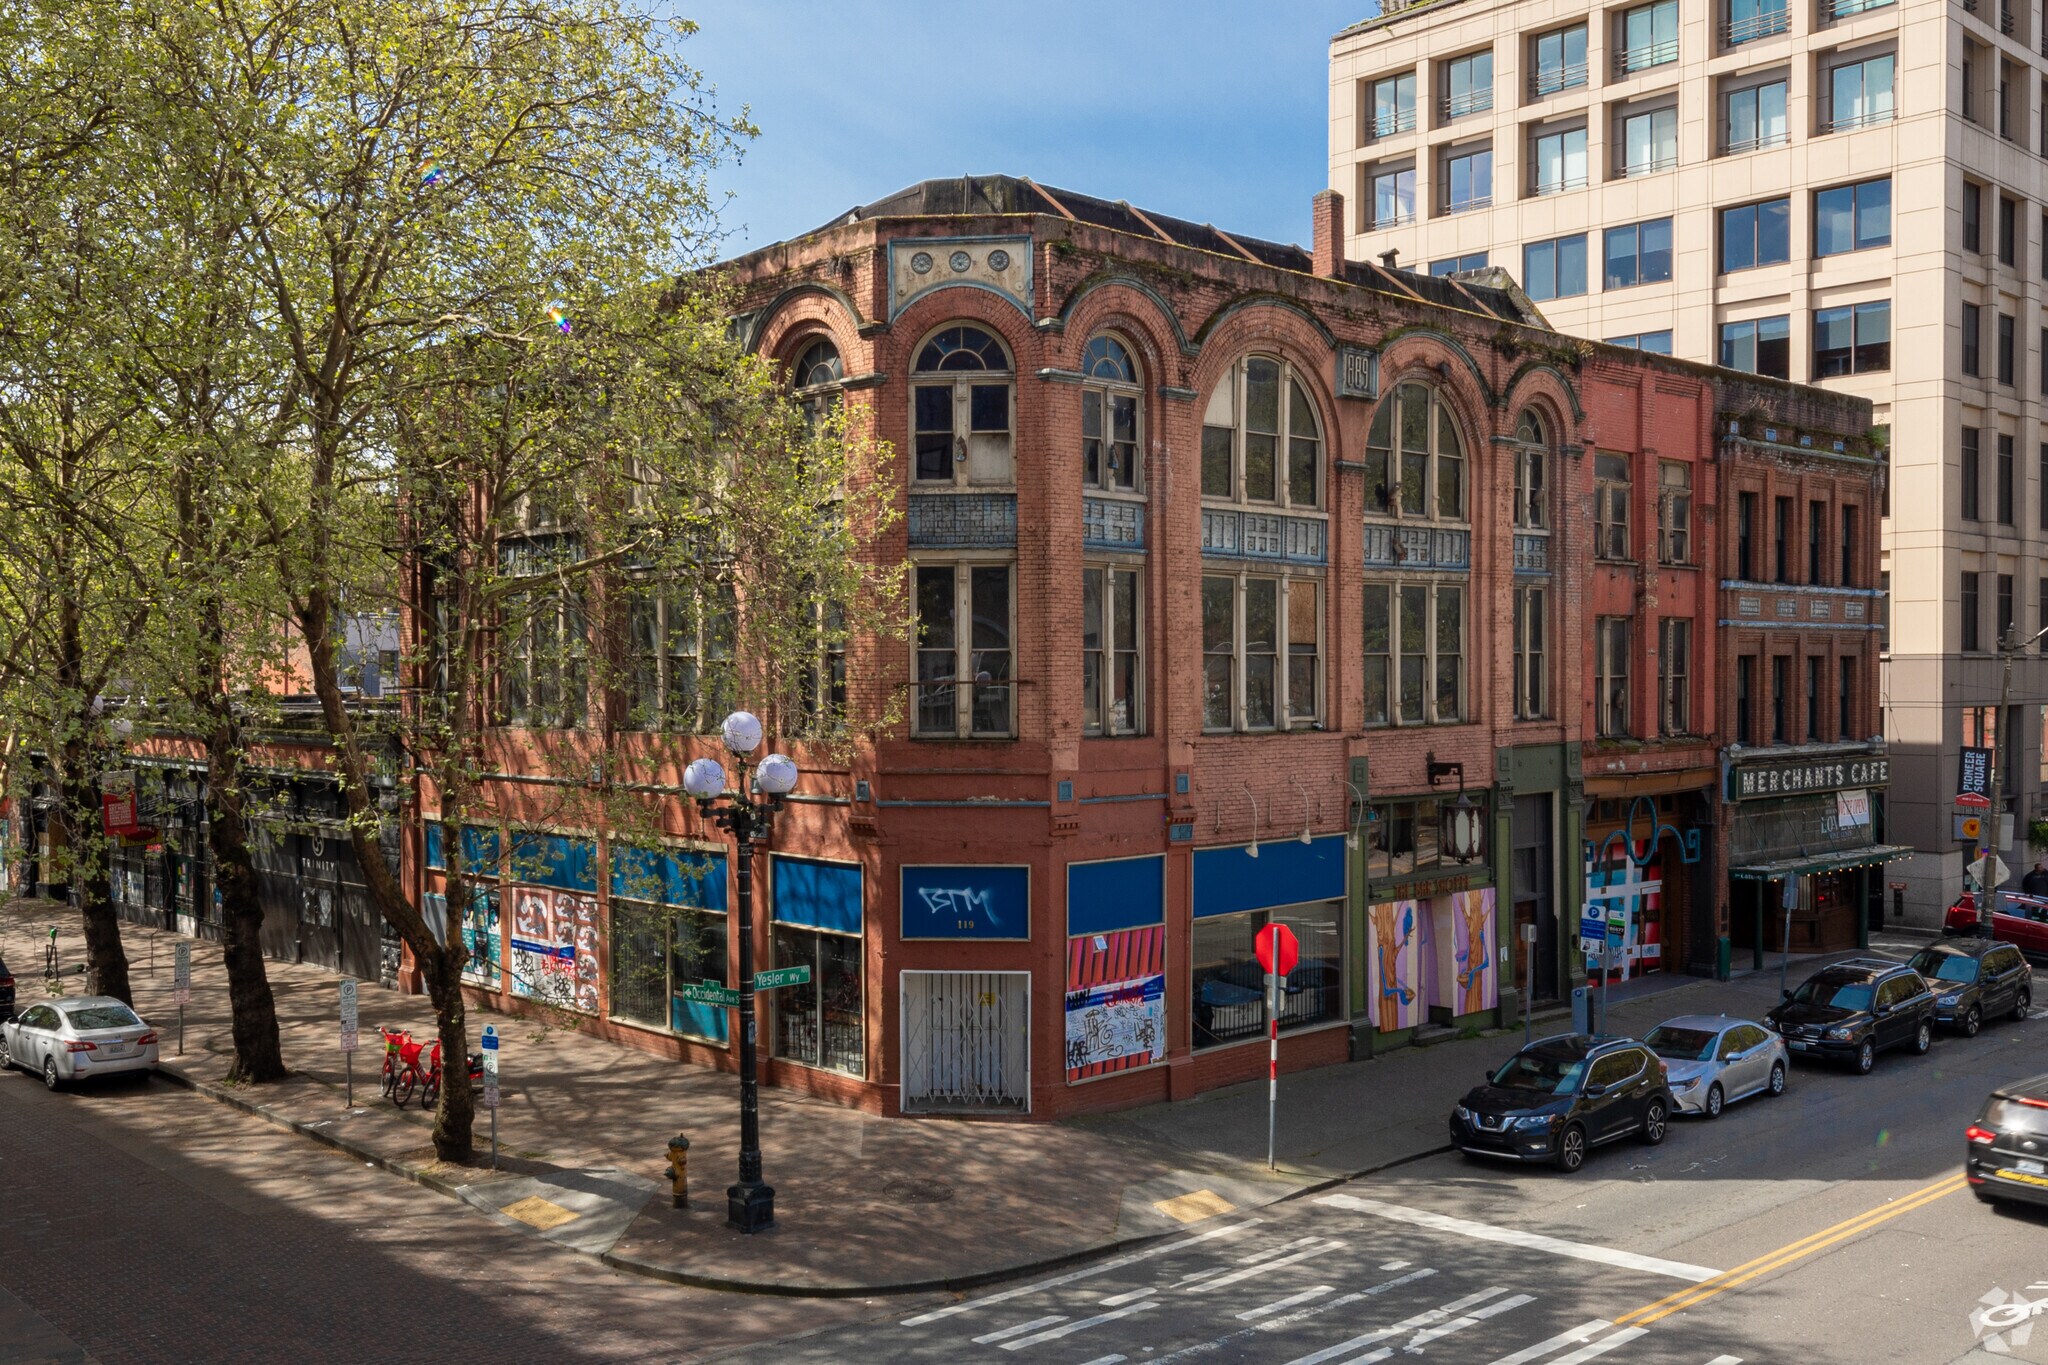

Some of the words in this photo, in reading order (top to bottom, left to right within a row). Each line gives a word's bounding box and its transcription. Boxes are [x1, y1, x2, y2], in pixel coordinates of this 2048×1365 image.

[1343, 353, 1369, 389] 1889
[1742, 764, 1845, 794] MERCHANTS
[1851, 761, 1889, 784] CAFE
[1963, 751, 1975, 791] PIONEER
[1974, 753, 1986, 792] SQUARE
[302, 857, 335, 871] TRINITY
[1394, 881, 1411, 900] THE
[1414, 879, 1432, 898] BAR
[957, 920, 975, 929] 119
[756, 972, 785, 987] Yesler
[789, 973, 800, 983] Wy
[692, 987, 726, 1002] Occidental
